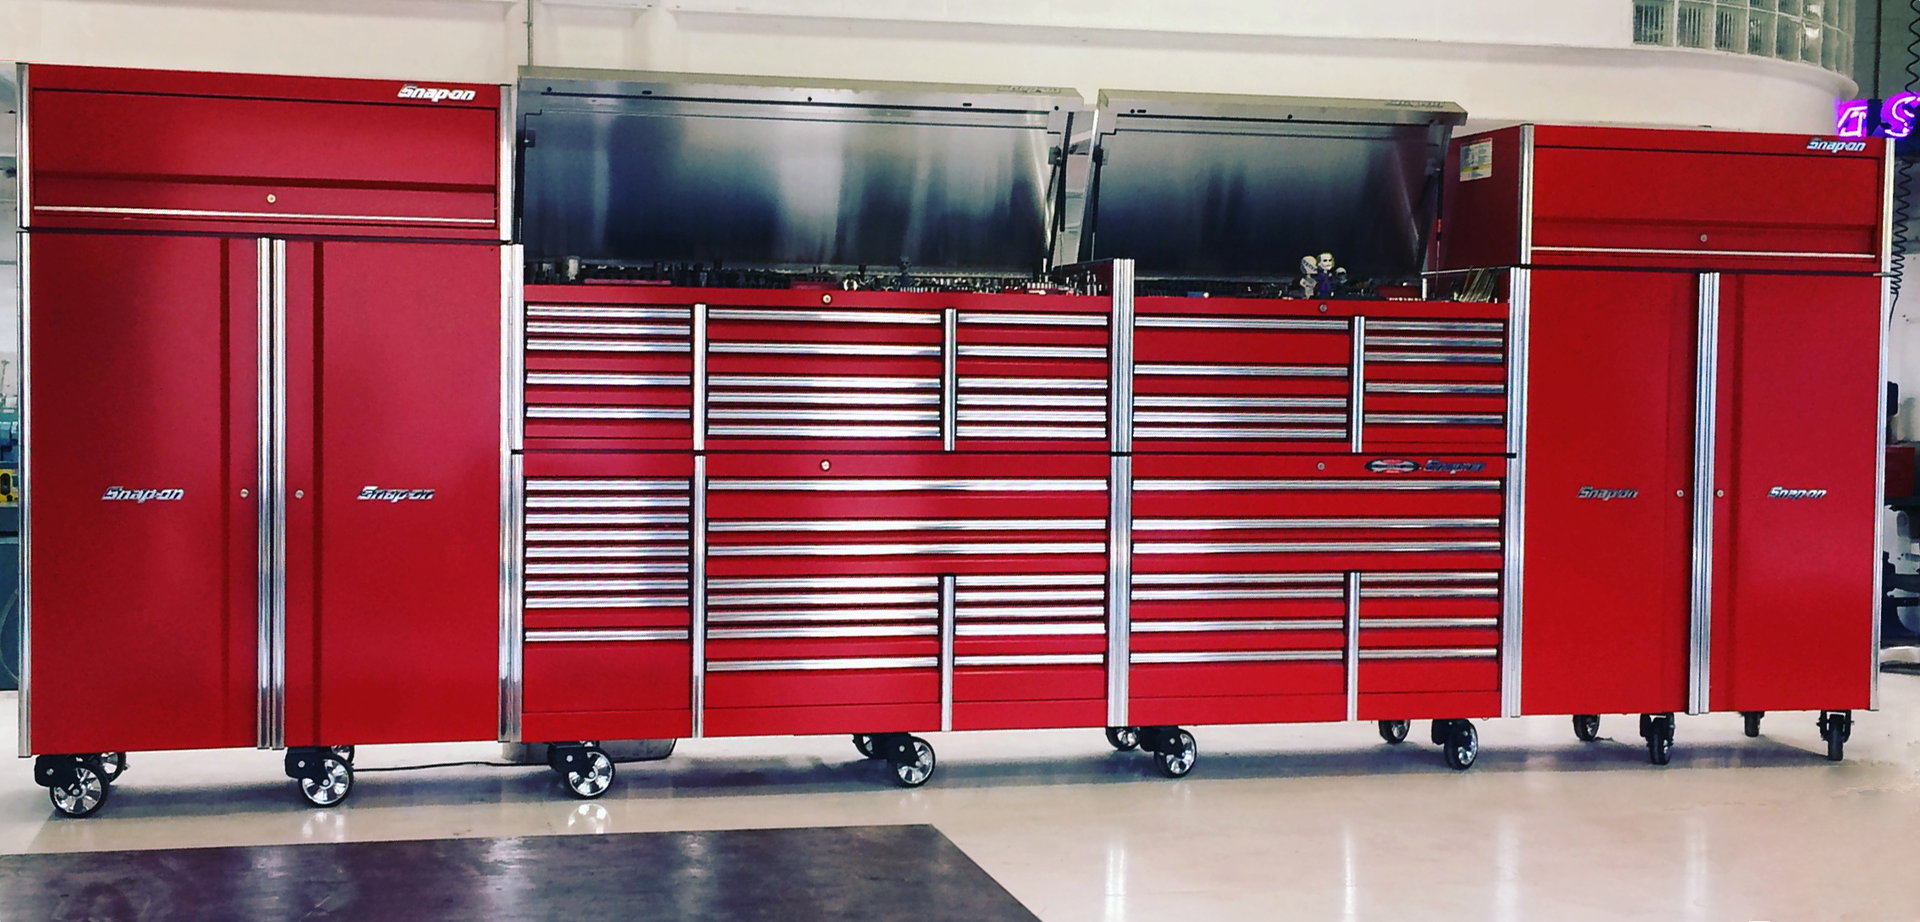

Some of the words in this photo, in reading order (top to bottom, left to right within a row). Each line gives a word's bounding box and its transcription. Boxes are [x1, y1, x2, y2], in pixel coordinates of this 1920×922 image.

[396, 84, 476, 102] Snap-on
[1806, 138, 1867, 153] Snap-on
[101, 485, 185, 503] Snap-on
[356, 485, 436, 503] Snap-on
[1576, 485, 1639, 501] Snap-on
[1767, 486, 1827, 501] Snap-on
